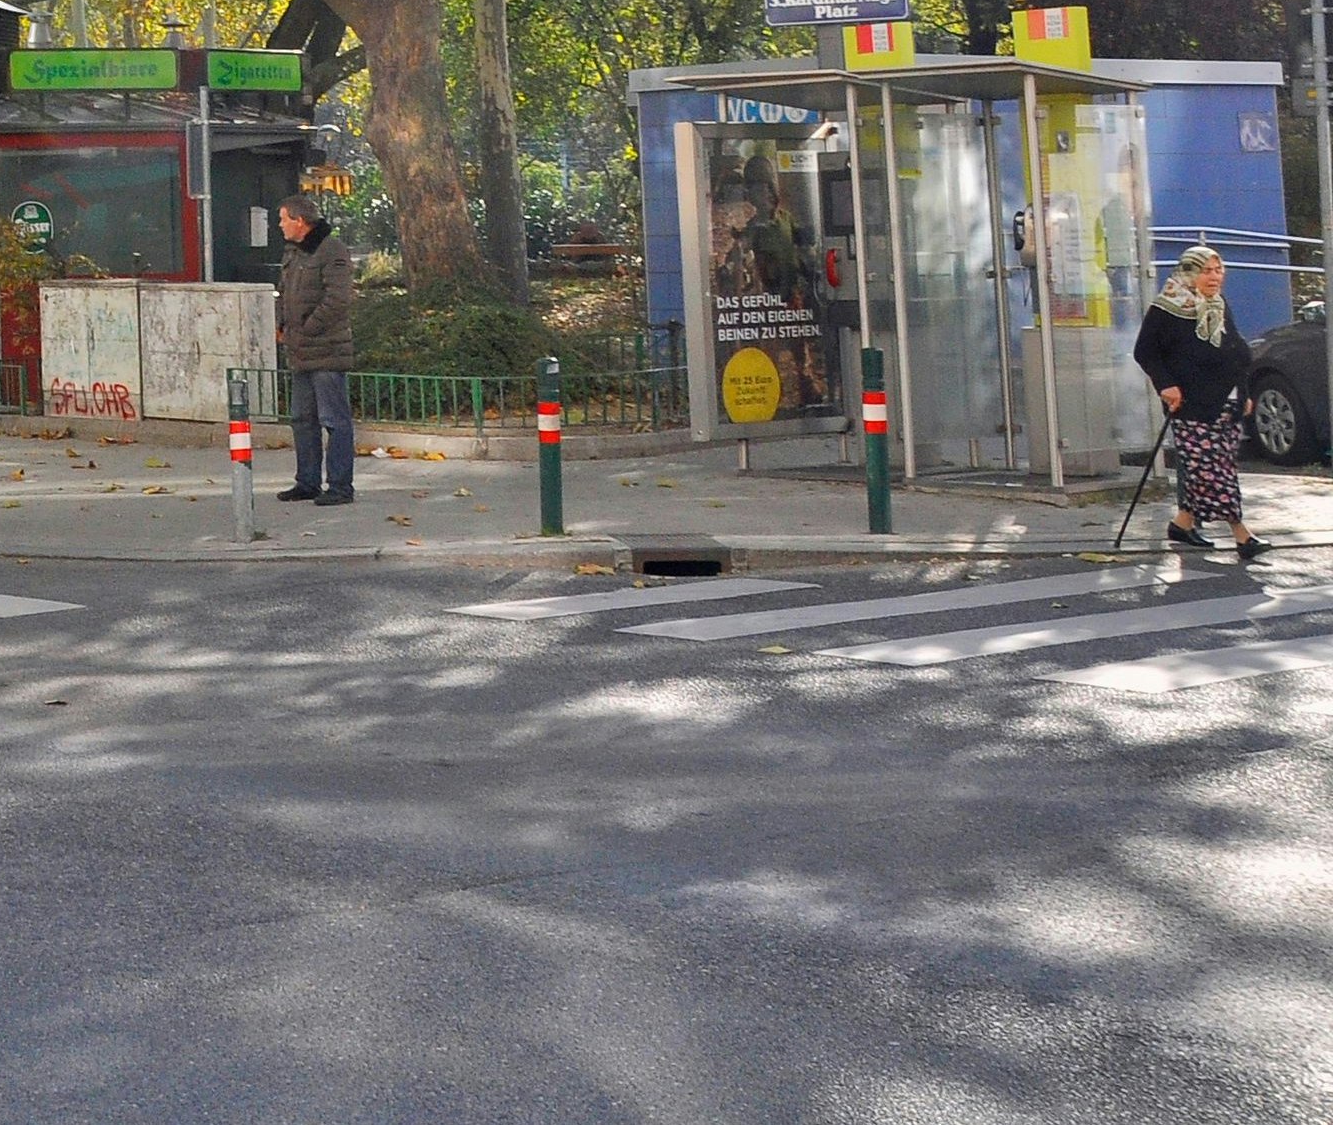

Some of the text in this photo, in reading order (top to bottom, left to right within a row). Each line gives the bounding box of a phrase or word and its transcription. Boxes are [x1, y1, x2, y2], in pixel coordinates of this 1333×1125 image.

[814, 5, 859, 19] Platz
[24, 58, 158, 85] Spezialbiere
[716, 292, 788, 309] DAS GEFÜHL,
[717, 309, 814, 325] AUF DEN EIGENEN
[718, 328, 759, 341] BEINEN
[761, 326, 776, 339] ZU
